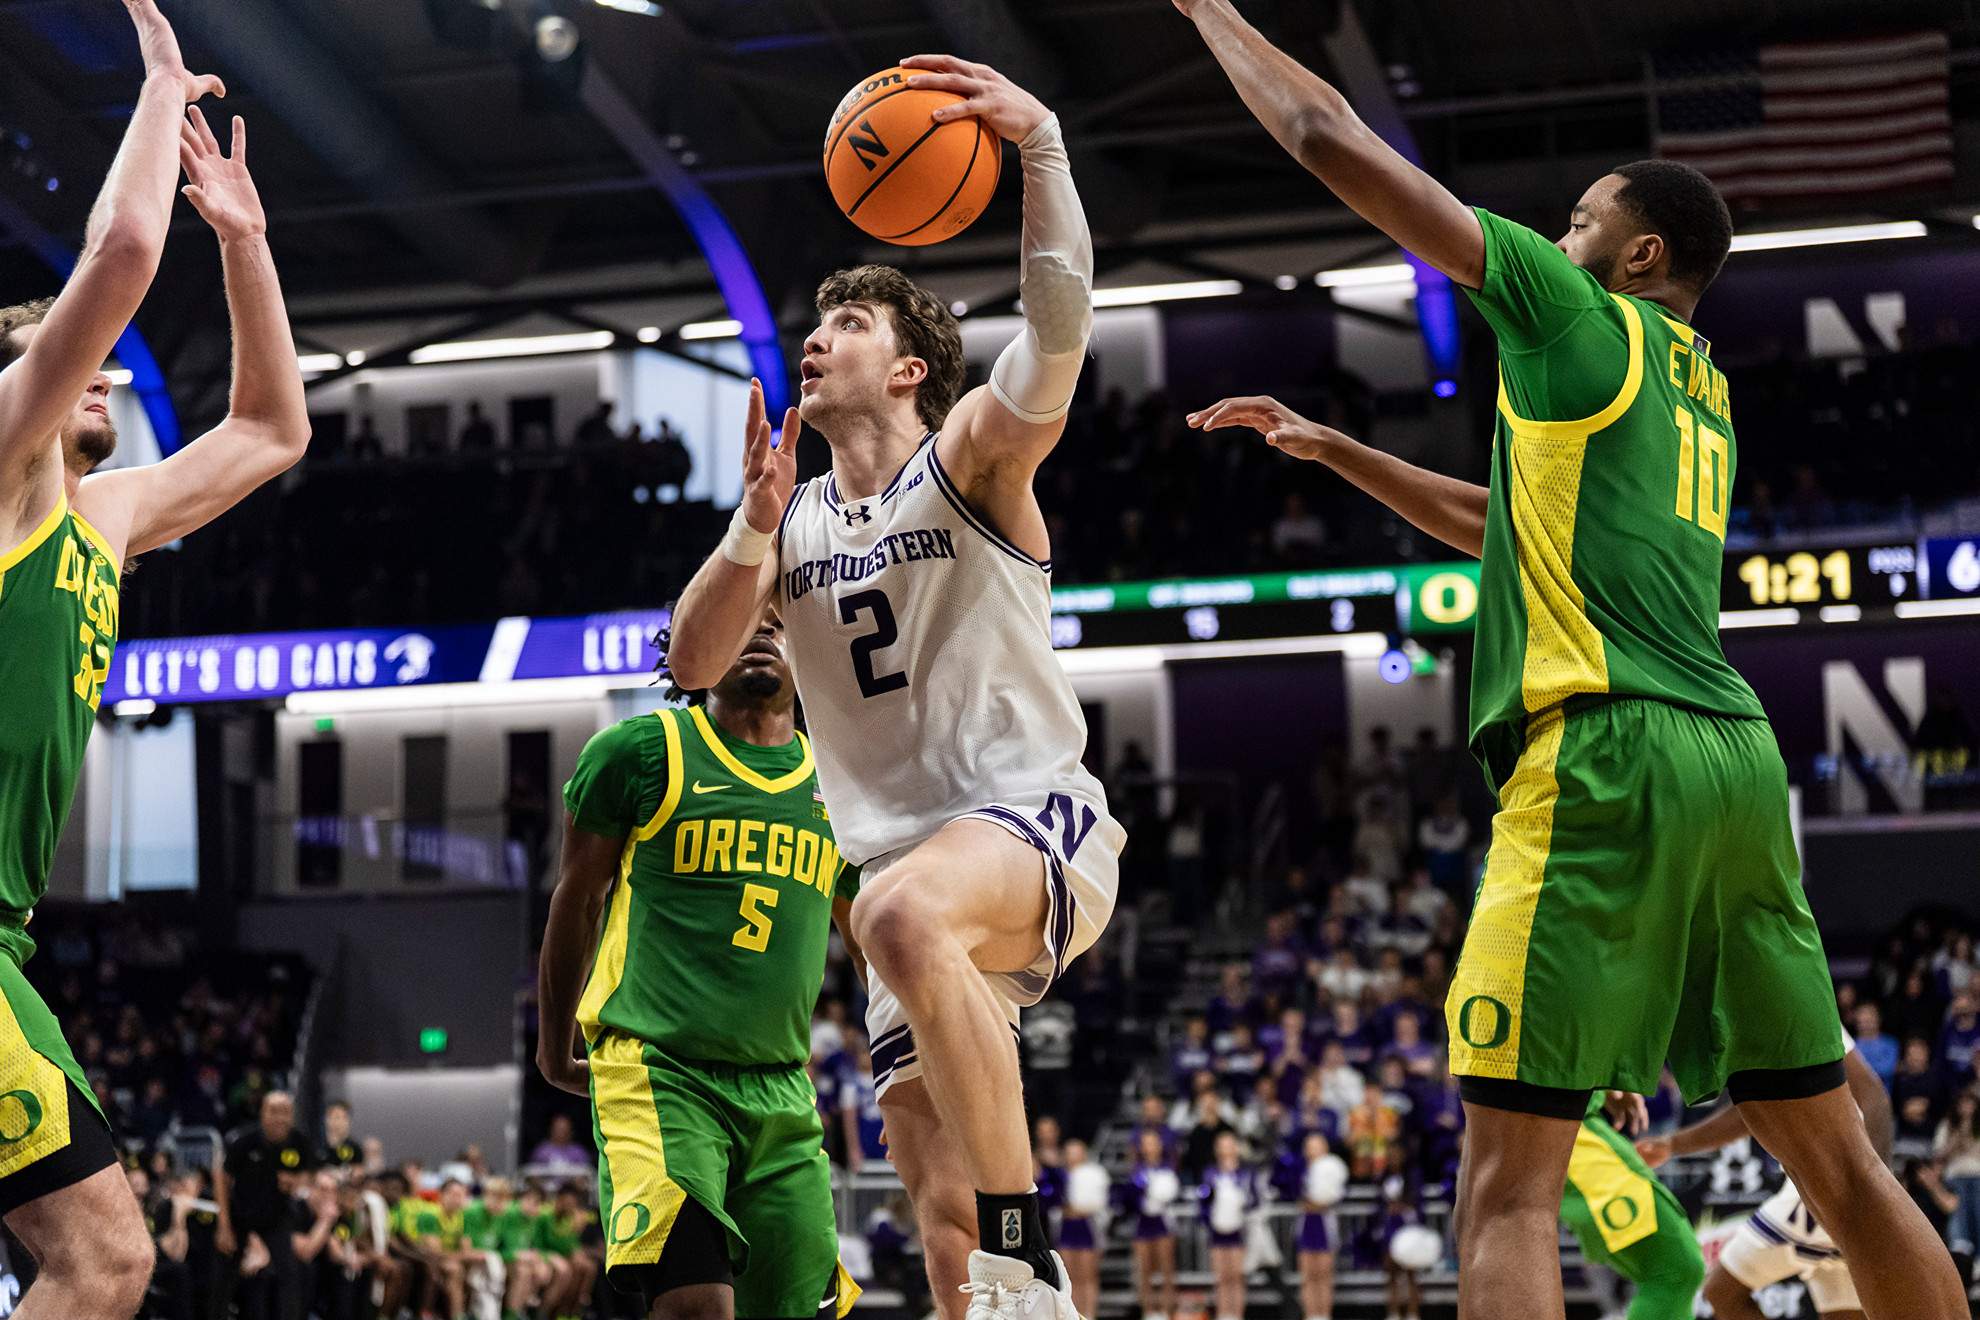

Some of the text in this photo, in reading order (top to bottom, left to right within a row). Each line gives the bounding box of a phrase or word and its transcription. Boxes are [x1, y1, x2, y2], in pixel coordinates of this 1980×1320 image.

[848, 120, 890, 172] N
[1669, 340, 1732, 424] EVANS
[1675, 404, 1729, 545] 10
[1419, 572, 1478, 624] O
[1738, 550, 1851, 605] 1:21
[125, 638, 377, 696] LET'S GO CATS
[583, 622, 661, 672] LET'
[838, 588, 910, 699] 2
[1822, 656, 1926, 816] N
[1035, 791, 1098, 865] N
[673, 819, 840, 899] OREGON
[731, 882, 779, 953] 5
[1459, 994, 1512, 1050] O
[610, 1202, 650, 1245] O
[1602, 1196, 1638, 1231] O
